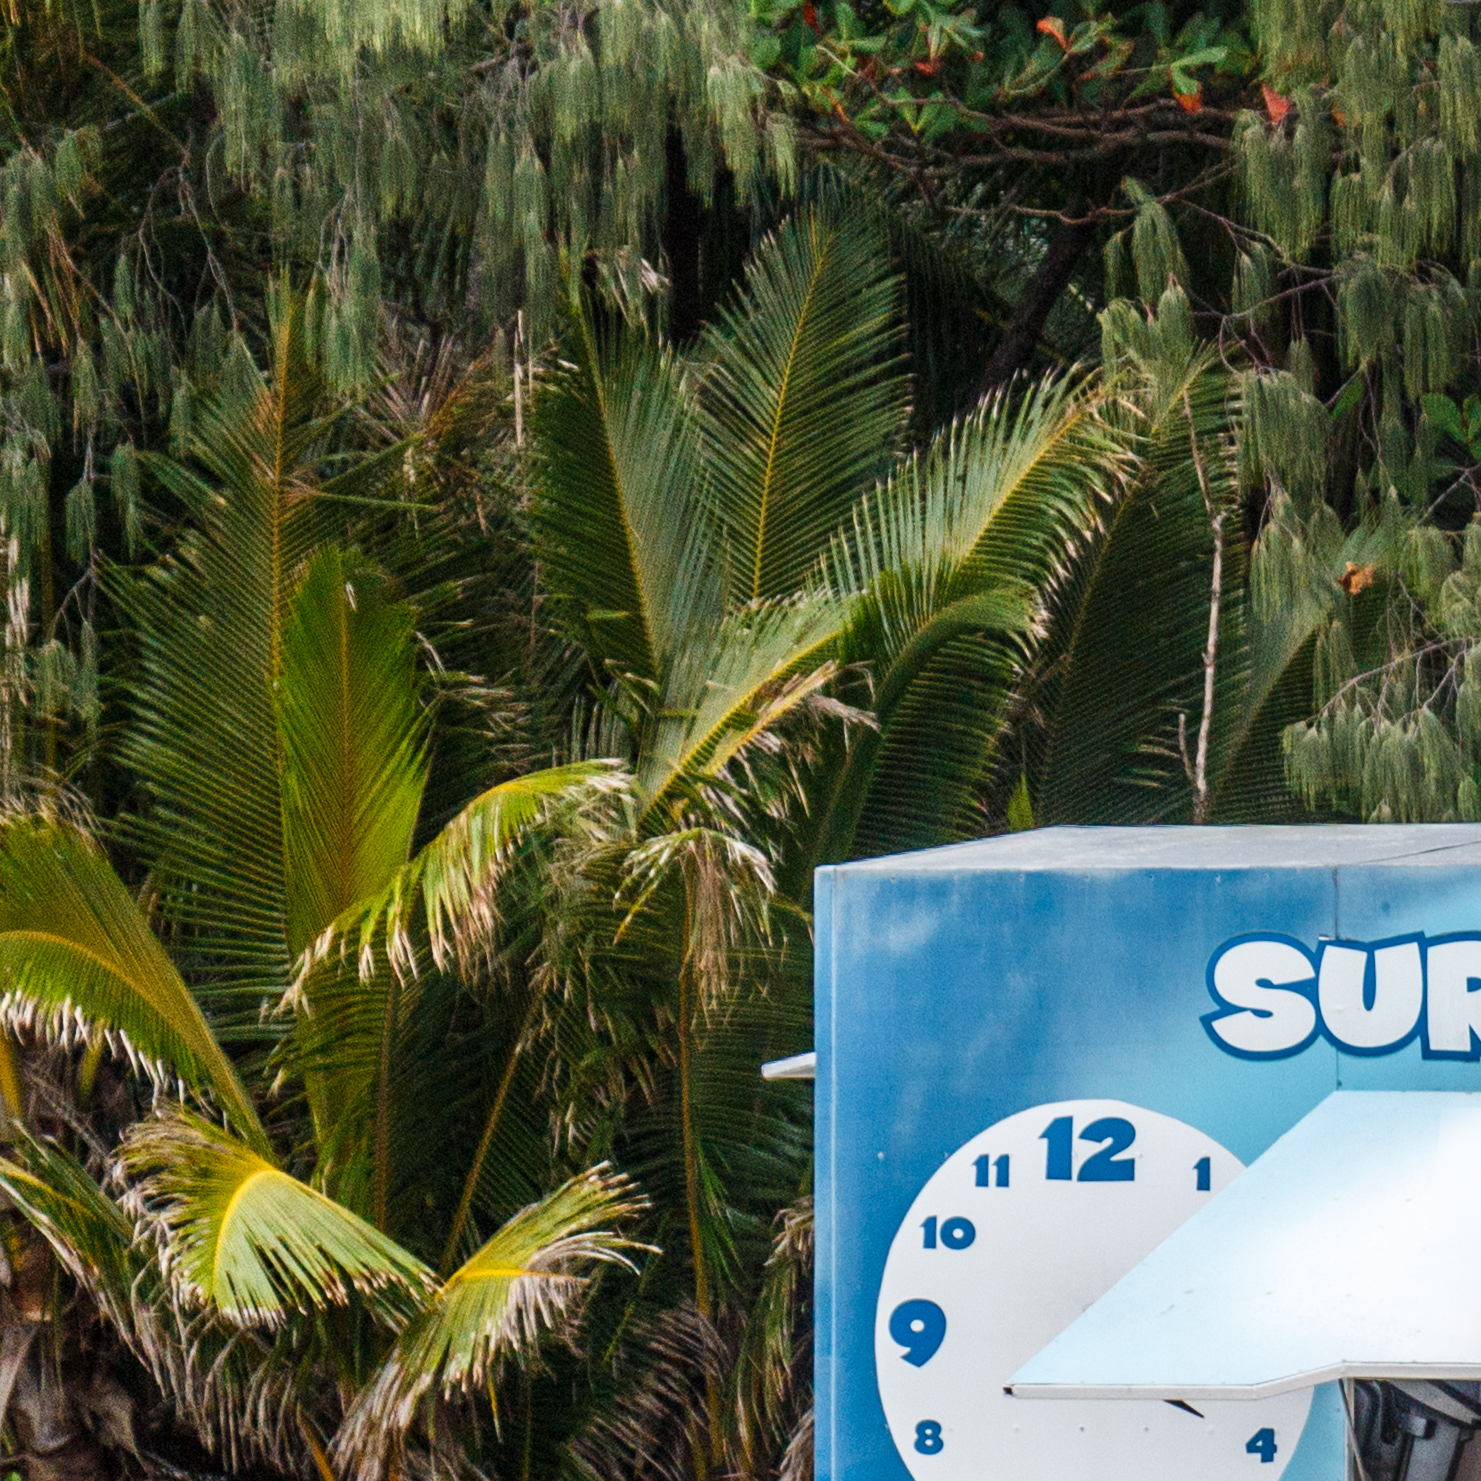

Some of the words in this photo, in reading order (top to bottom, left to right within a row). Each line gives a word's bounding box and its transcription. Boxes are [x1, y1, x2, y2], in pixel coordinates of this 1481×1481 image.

[1038, 1115, 1137, 1182] 12
[971, 1153, 1010, 1188] 11
[1192, 1156, 1211, 1192] 1
[919, 1215, 977, 1251] 10
[888, 1298, 947, 1368] 9
[914, 1419, 945, 1456] 8
[1245, 1427, 1278, 1464] 4
